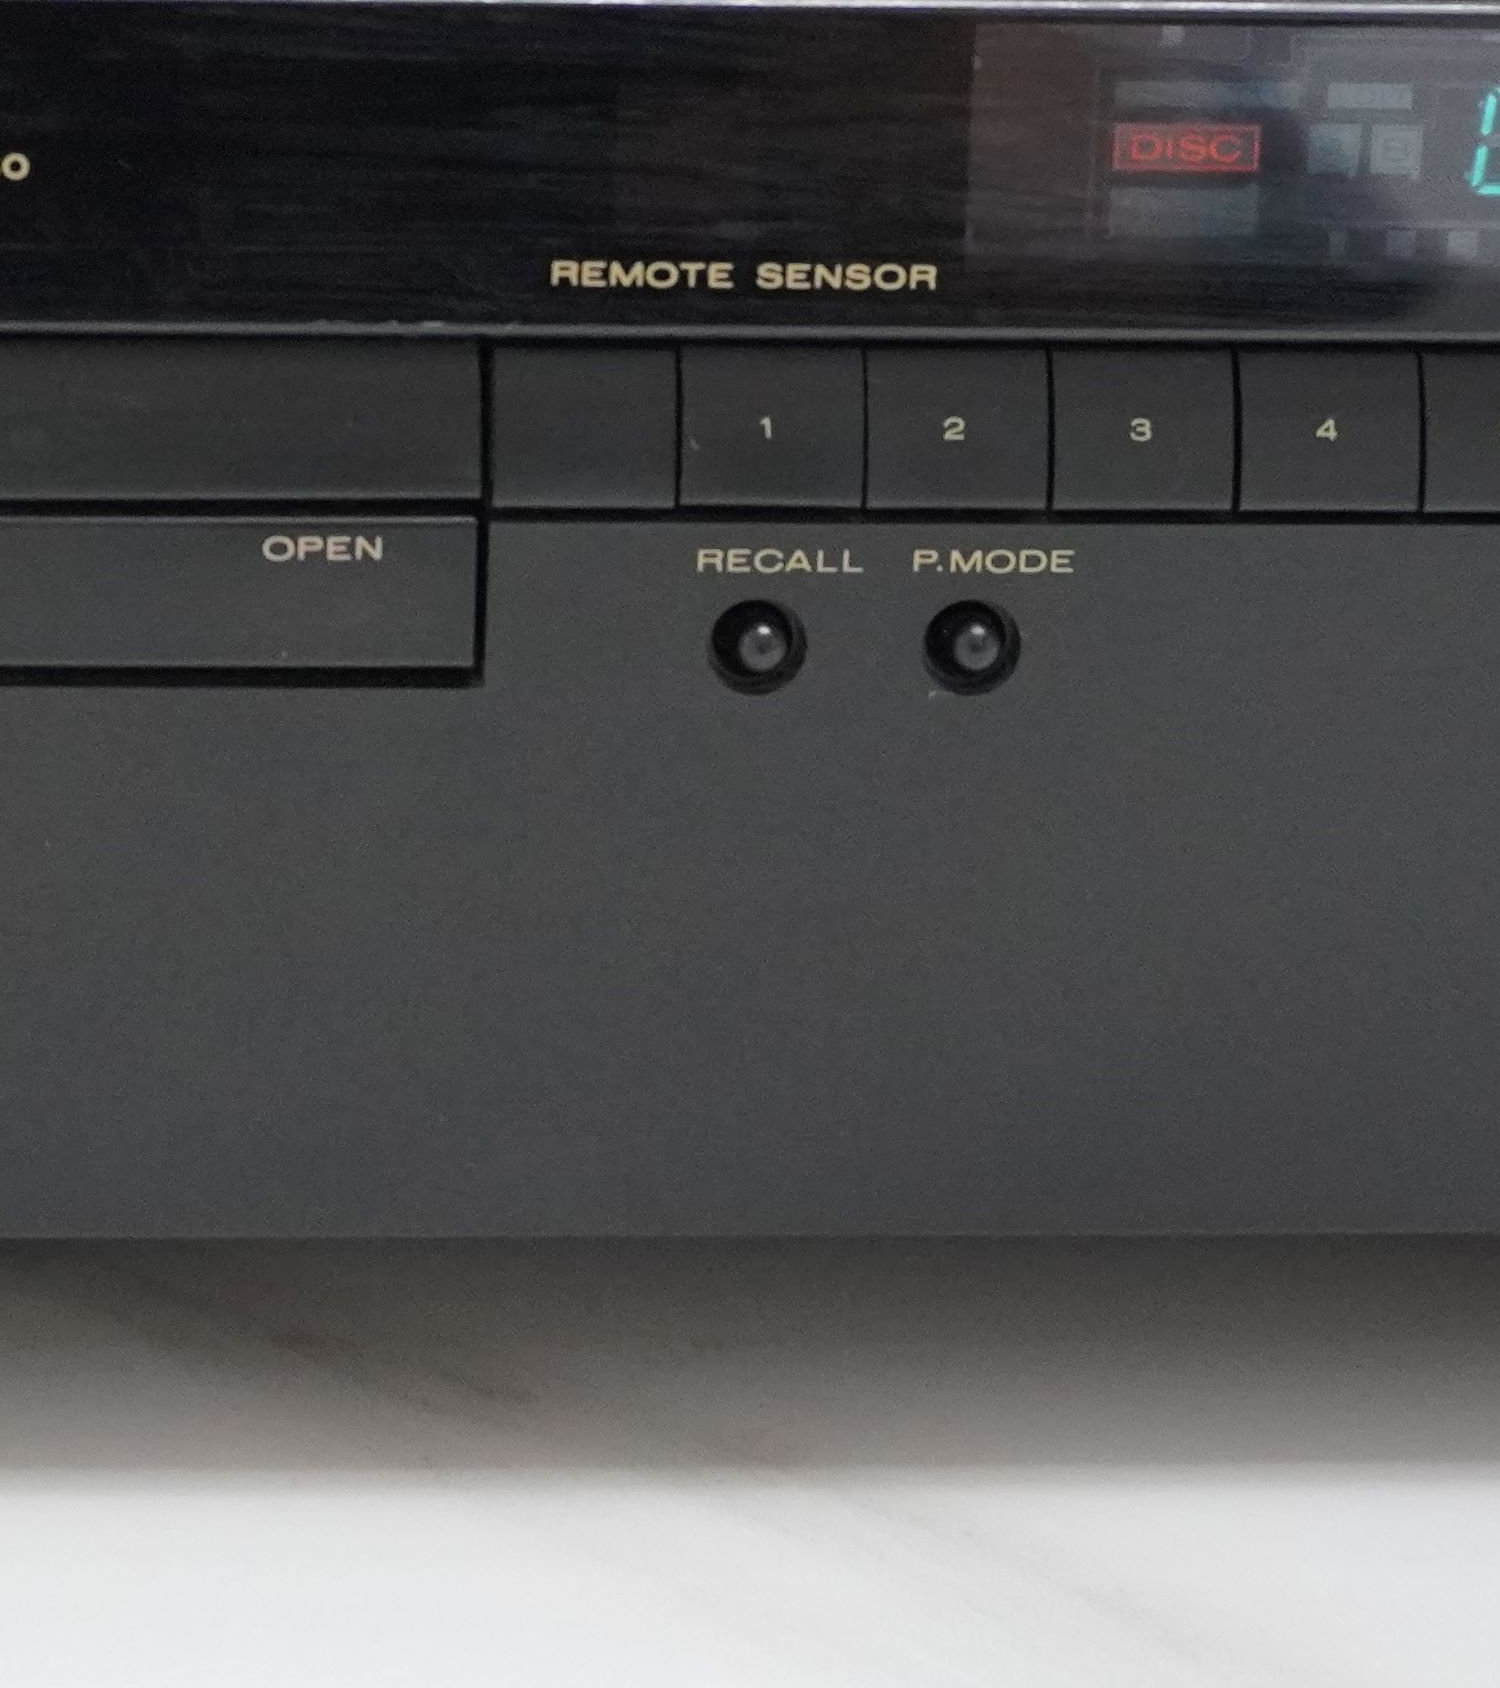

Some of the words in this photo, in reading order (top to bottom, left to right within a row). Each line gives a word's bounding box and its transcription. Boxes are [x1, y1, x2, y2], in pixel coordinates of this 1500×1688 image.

[1130, 133, 1240, 163] DISC
[550, 259, 734, 289] REMOTE
[756, 262, 938, 291] SENSOR
[760, 416, 772, 439] 1
[943, 416, 966, 441] 2
[1129, 417, 1152, 442] 3
[1315, 418, 1338, 441] 4
[262, 535, 383, 562] OPEN
[696, 548, 864, 574] RECALL
